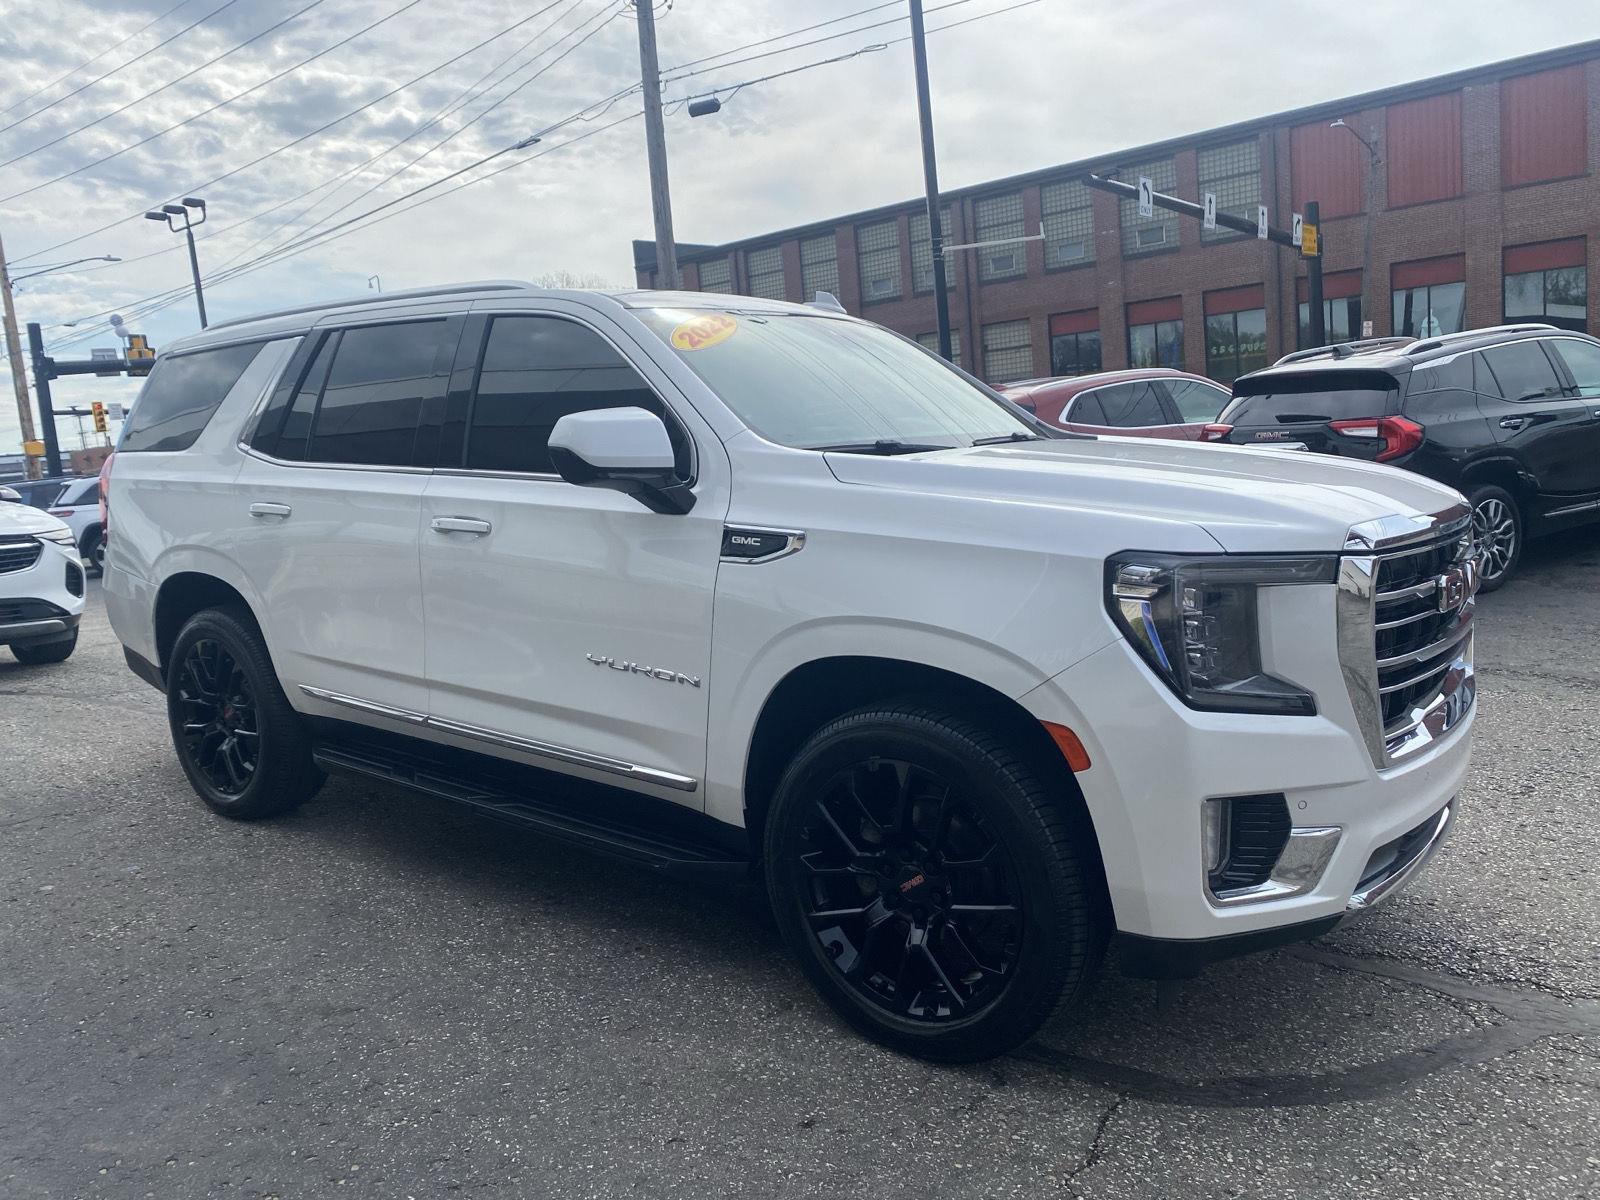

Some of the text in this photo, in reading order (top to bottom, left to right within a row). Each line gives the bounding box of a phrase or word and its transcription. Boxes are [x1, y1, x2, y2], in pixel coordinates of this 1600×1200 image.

[678, 315, 736, 347] 2022
[1255, 431, 1290, 439] GMC
[731, 536, 761, 546] GMC
[586, 653, 701, 688] YUKON
